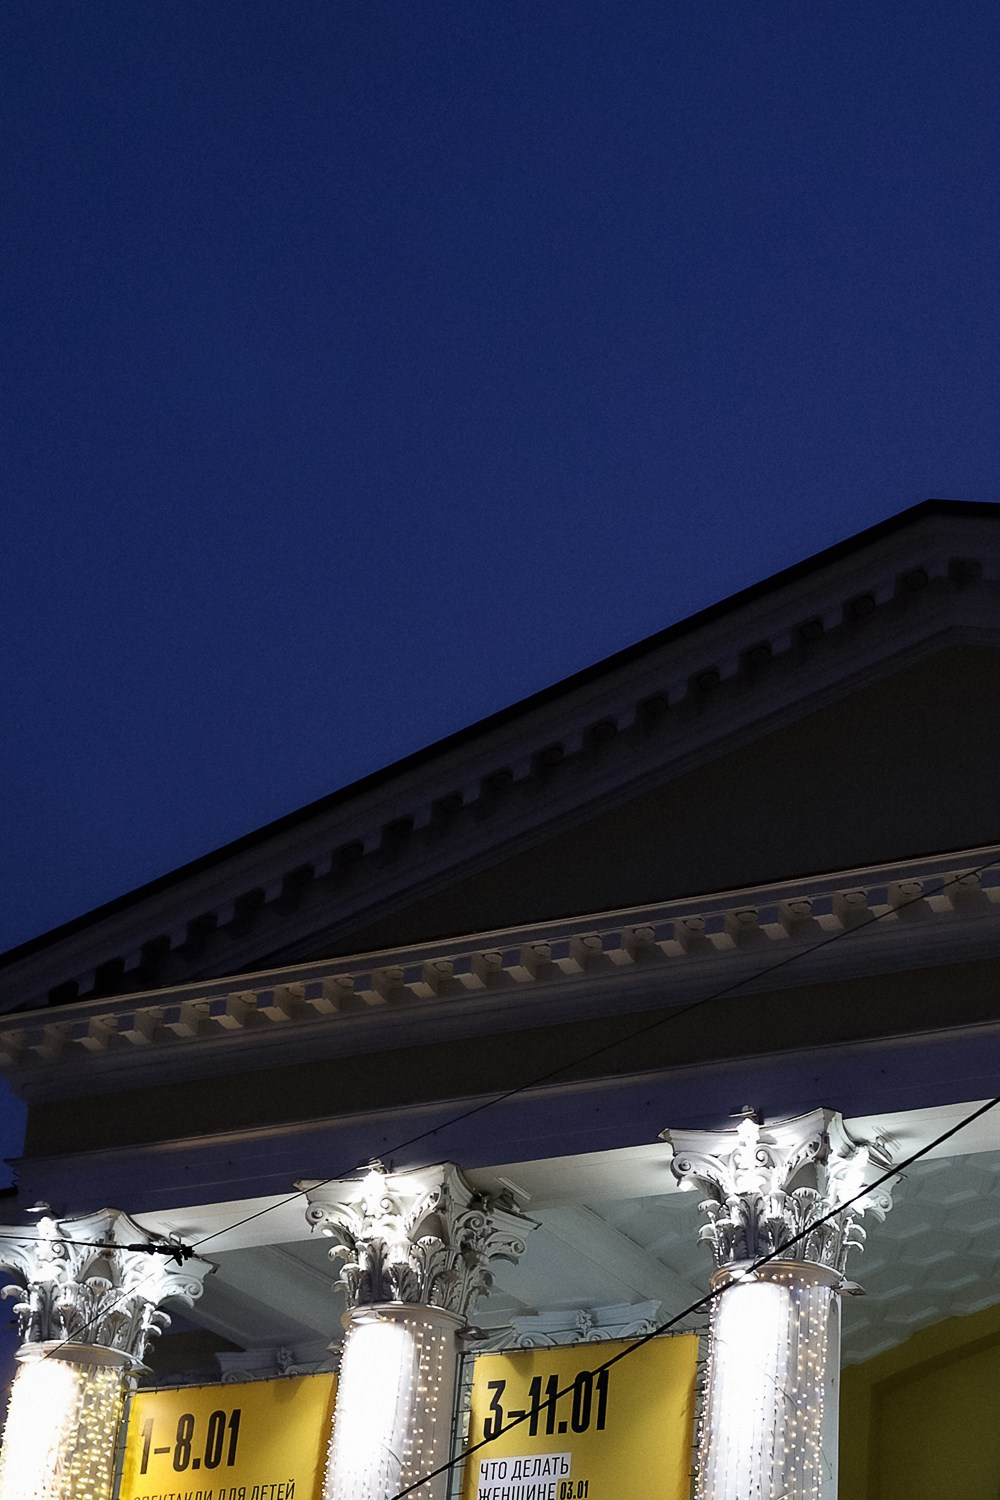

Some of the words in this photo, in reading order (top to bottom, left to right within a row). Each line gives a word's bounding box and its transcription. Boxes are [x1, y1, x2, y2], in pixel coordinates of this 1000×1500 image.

[140, 1409, 242, 1475] 1-8.01
[480, 1461, 507, 1480] ЧТО
[511, 1456, 569, 1481] ДЕЛАТЬ
[560, 1480, 589, 1500] 03.01
